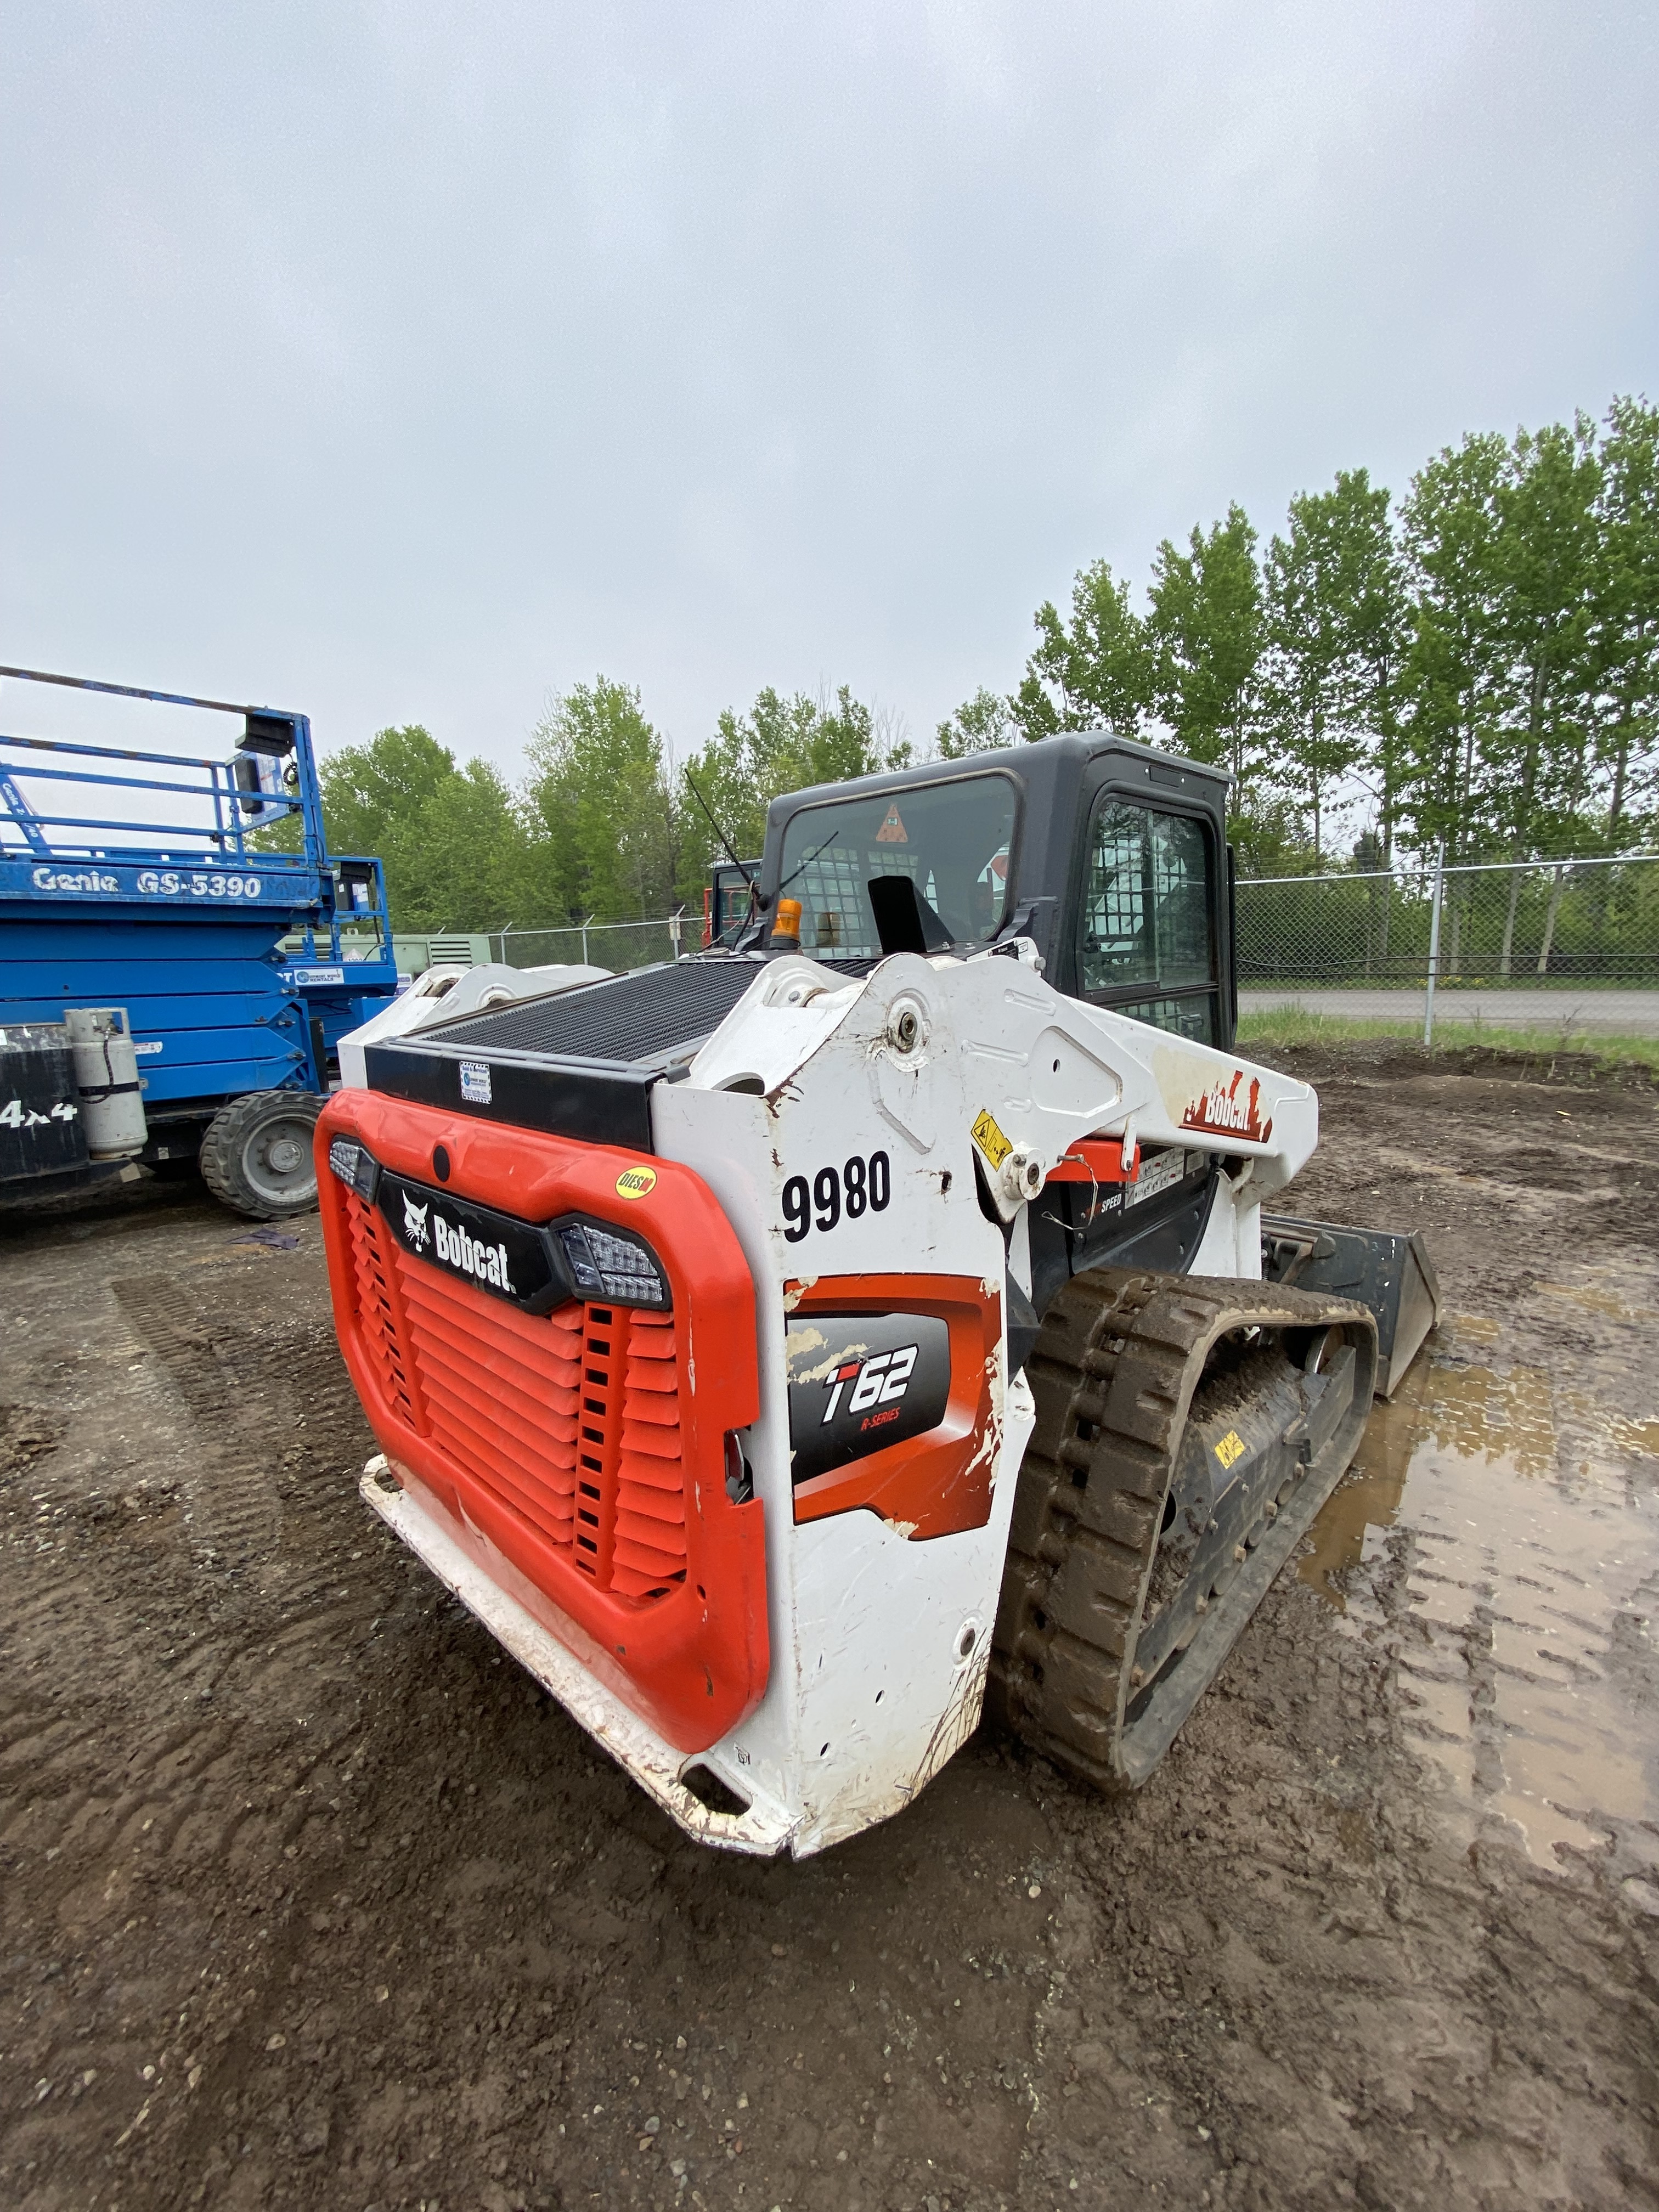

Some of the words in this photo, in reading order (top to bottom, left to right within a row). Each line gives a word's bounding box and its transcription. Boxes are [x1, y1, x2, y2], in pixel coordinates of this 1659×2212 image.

[33, 867, 119, 892] Genie
[137, 872, 261, 898] GS-5390
[782, 1150, 890, 1243] 9980
[1101, 1193, 1122, 1213] SPEED
[433, 1214, 510, 1292] Bobcat
[822, 1345, 918, 1424] T62
[861, 1407, 901, 1431] R-SERIES
